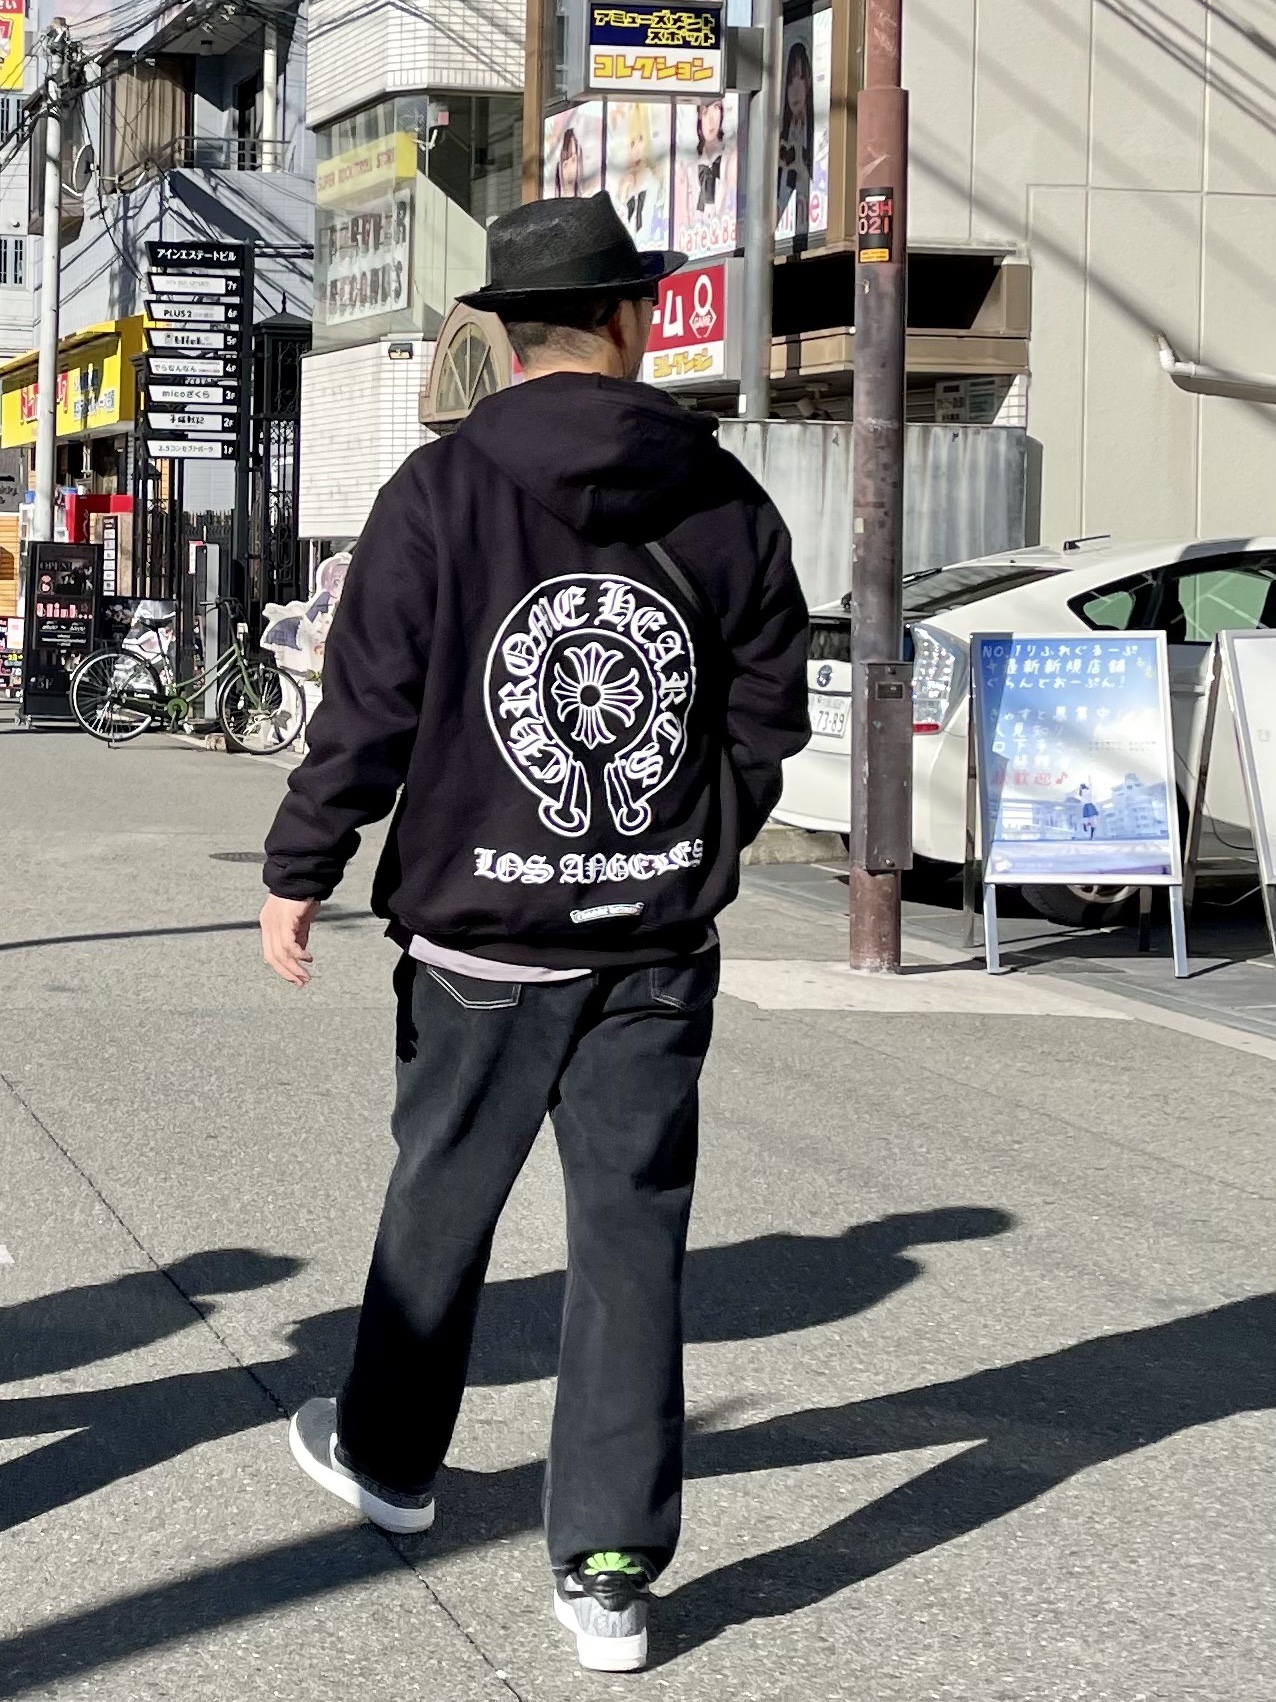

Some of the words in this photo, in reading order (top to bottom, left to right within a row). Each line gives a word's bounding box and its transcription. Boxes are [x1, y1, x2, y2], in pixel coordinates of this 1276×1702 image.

[594, 10, 715, 32] アミューズメント
[645, 28, 715, 46] スポット
[593, 54, 713, 81] コレクション
[859, 199, 892, 218] 03H
[859, 216, 889, 235] 021
[156, 248, 237, 262] アインエステートビル
[473, 847, 555, 885] LOS
[559, 838, 704, 885] ANGELES
